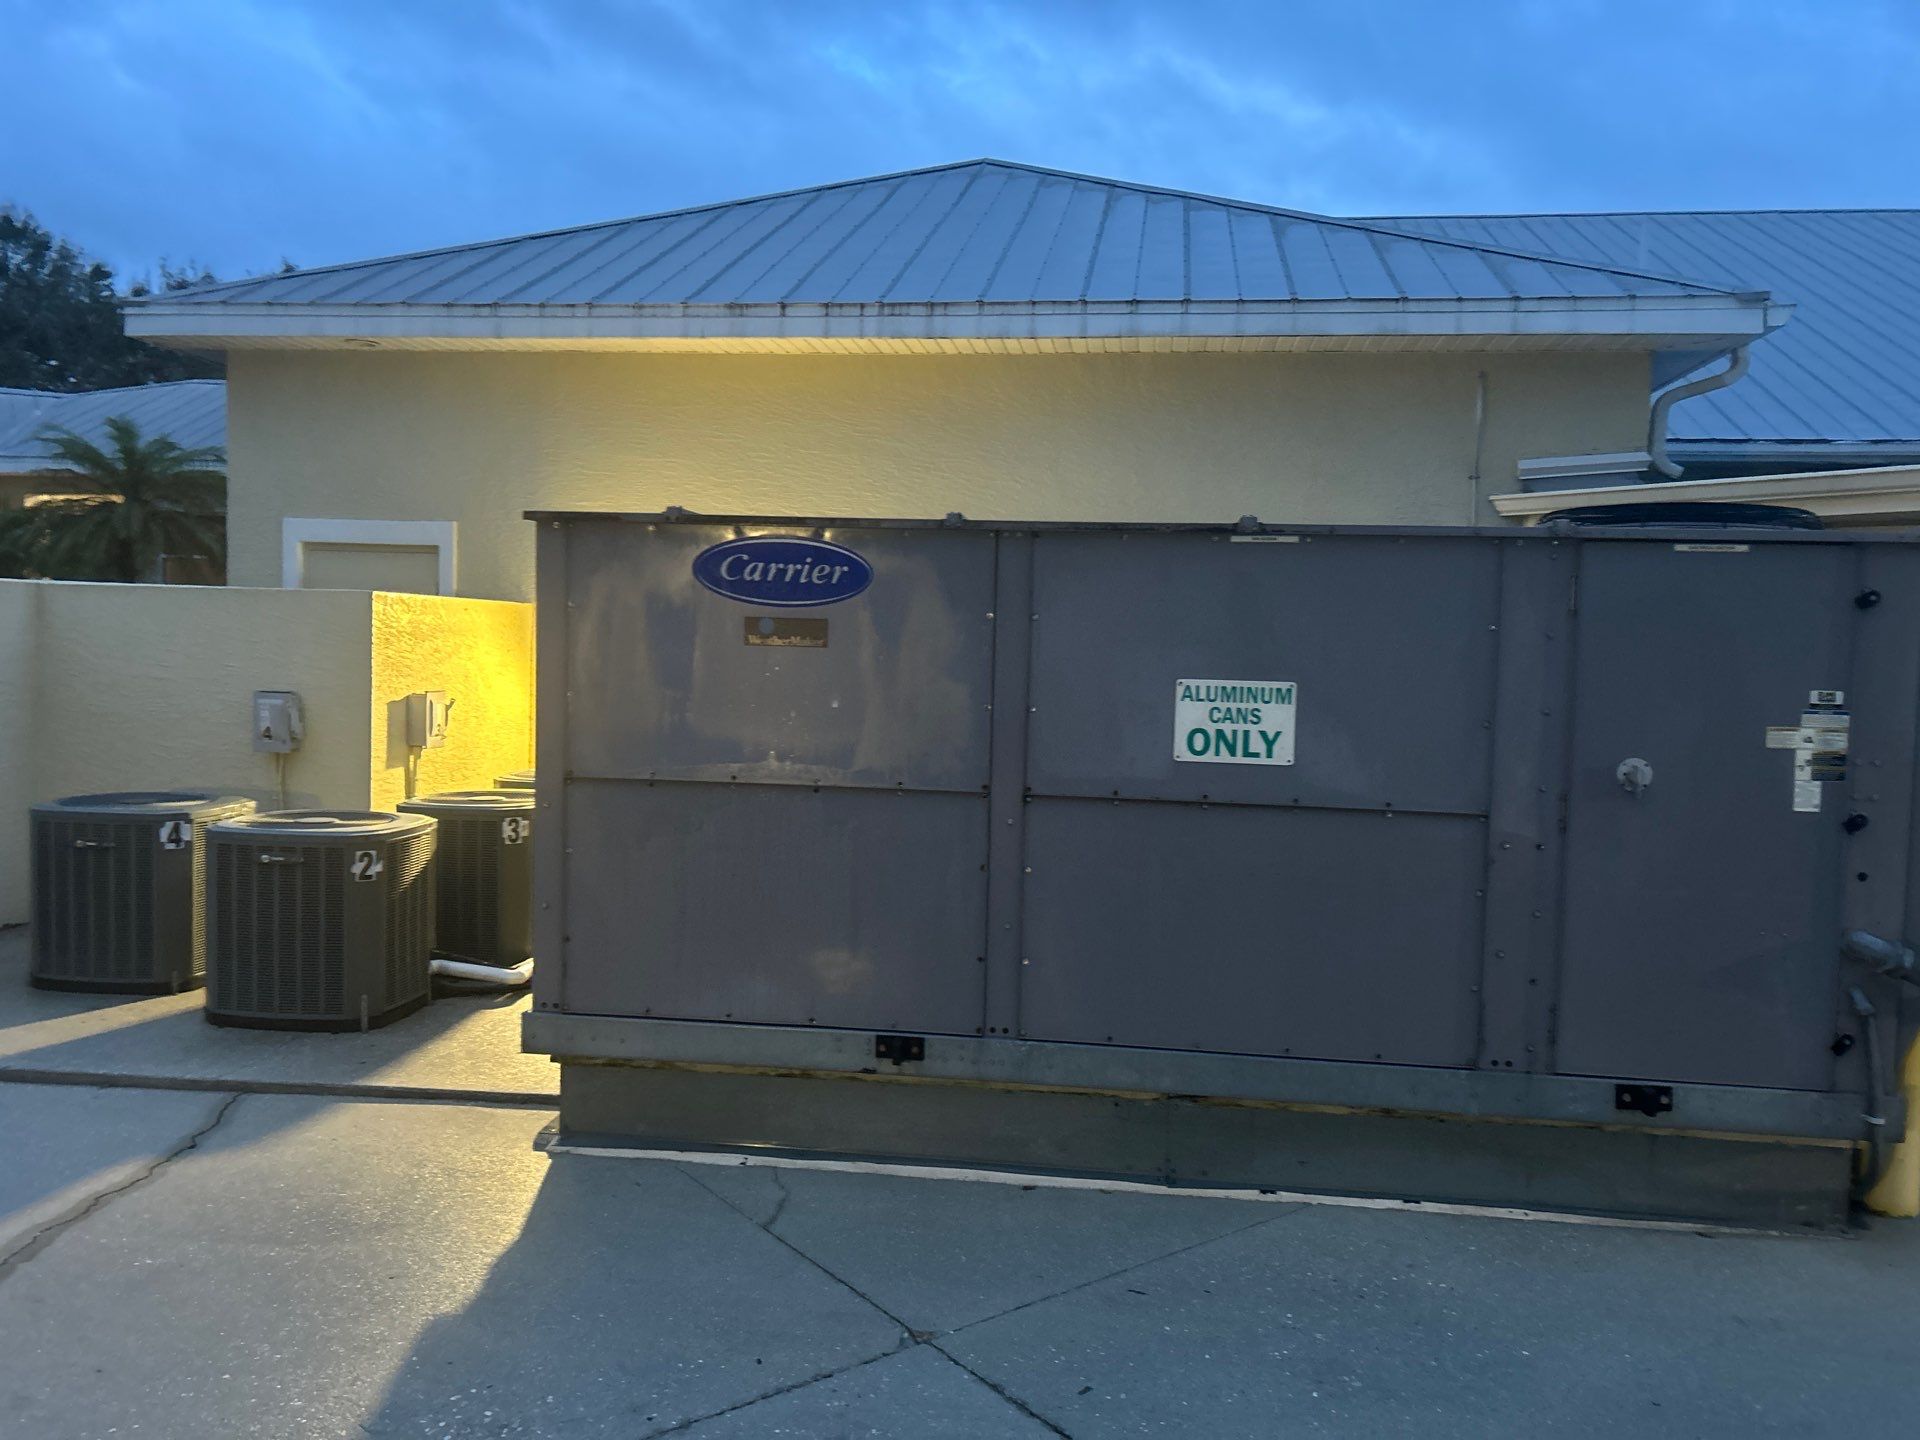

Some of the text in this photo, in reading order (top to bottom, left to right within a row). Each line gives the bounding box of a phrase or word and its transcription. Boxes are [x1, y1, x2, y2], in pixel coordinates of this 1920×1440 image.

[720, 554, 849, 585] Carrier
[1180, 684, 1293, 705] ALUMINUM
[1208, 706, 1262, 725] CANS
[1186, 727, 1283, 759] ONLY
[166, 821, 184, 849] 4
[507, 818, 520, 844] 3
[358, 851, 374, 881] 2
